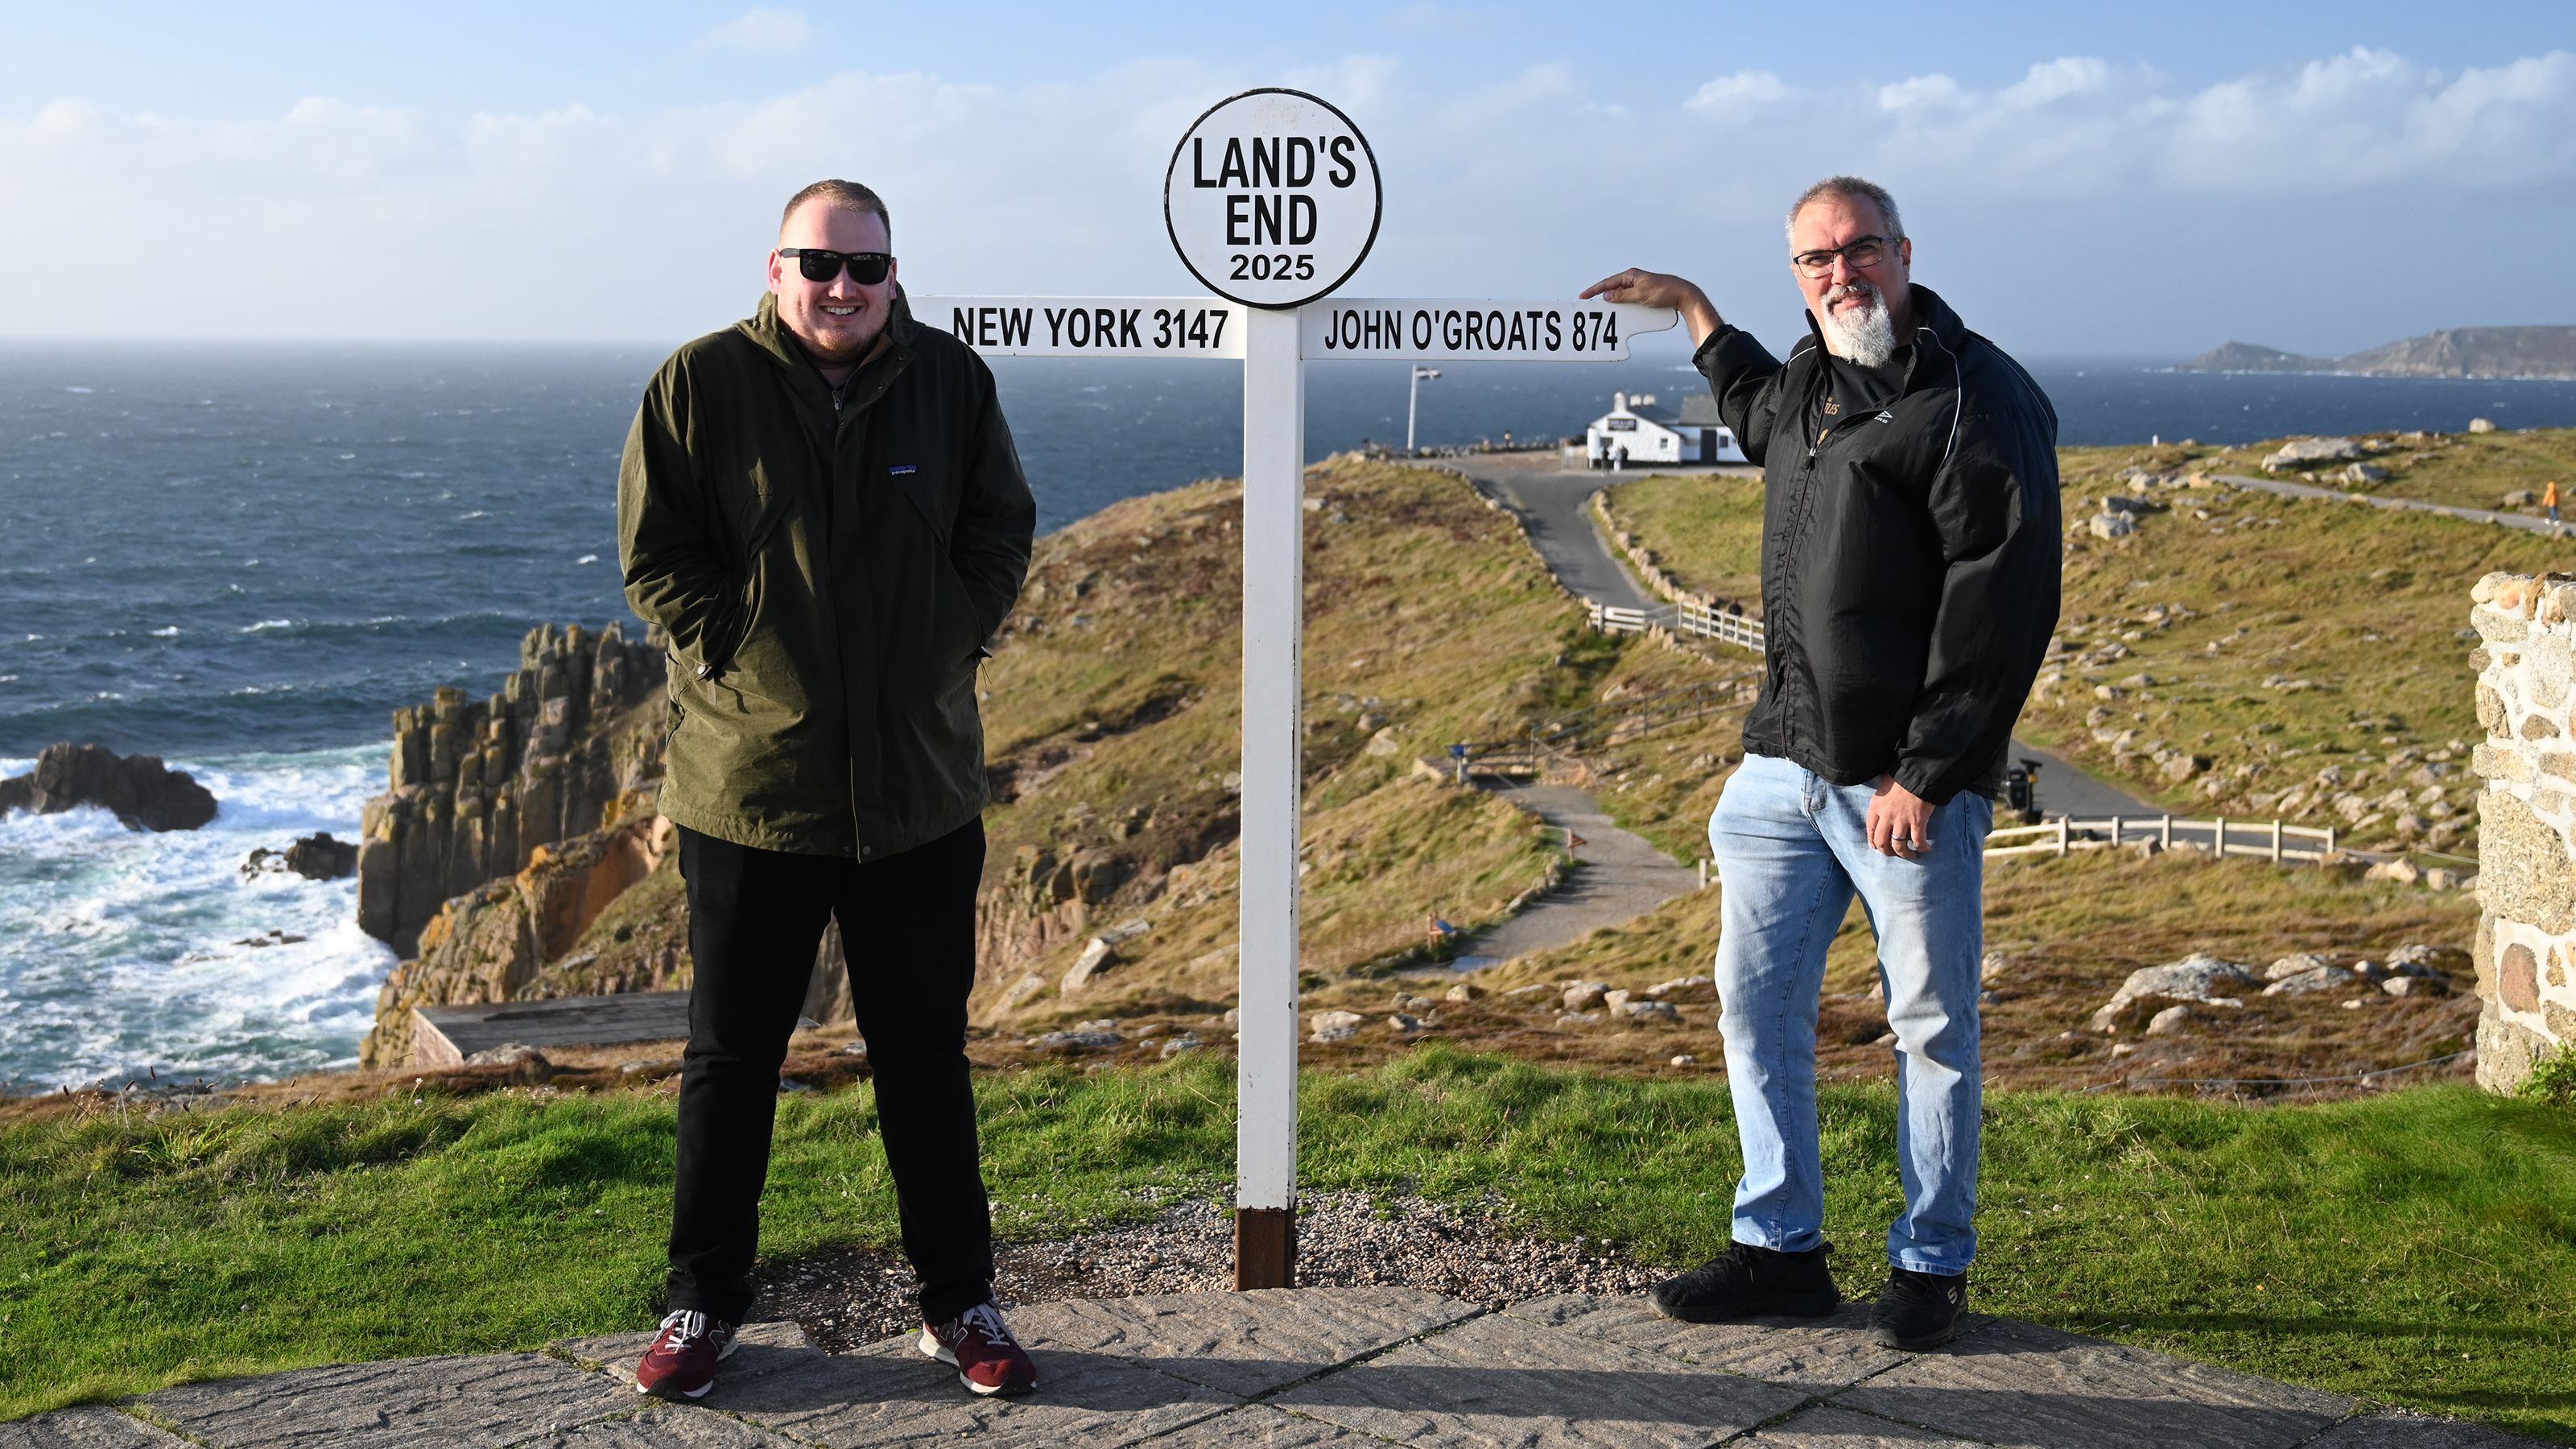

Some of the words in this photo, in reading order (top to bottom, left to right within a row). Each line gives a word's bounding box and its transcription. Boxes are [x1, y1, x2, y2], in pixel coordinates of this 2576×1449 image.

[1194, 135, 1357, 189] LAND'S
[1226, 194, 1318, 246] END
[1229, 254, 1315, 282] 2025
[953, 307, 1034, 347] NEW
[1043, 308, 1142, 349] YORK
[1153, 308, 1229, 349] 3147
[1324, 309, 1402, 351] JOHN
[1412, 309, 1563, 352] O'GROATS
[1572, 311, 1619, 353] 874
